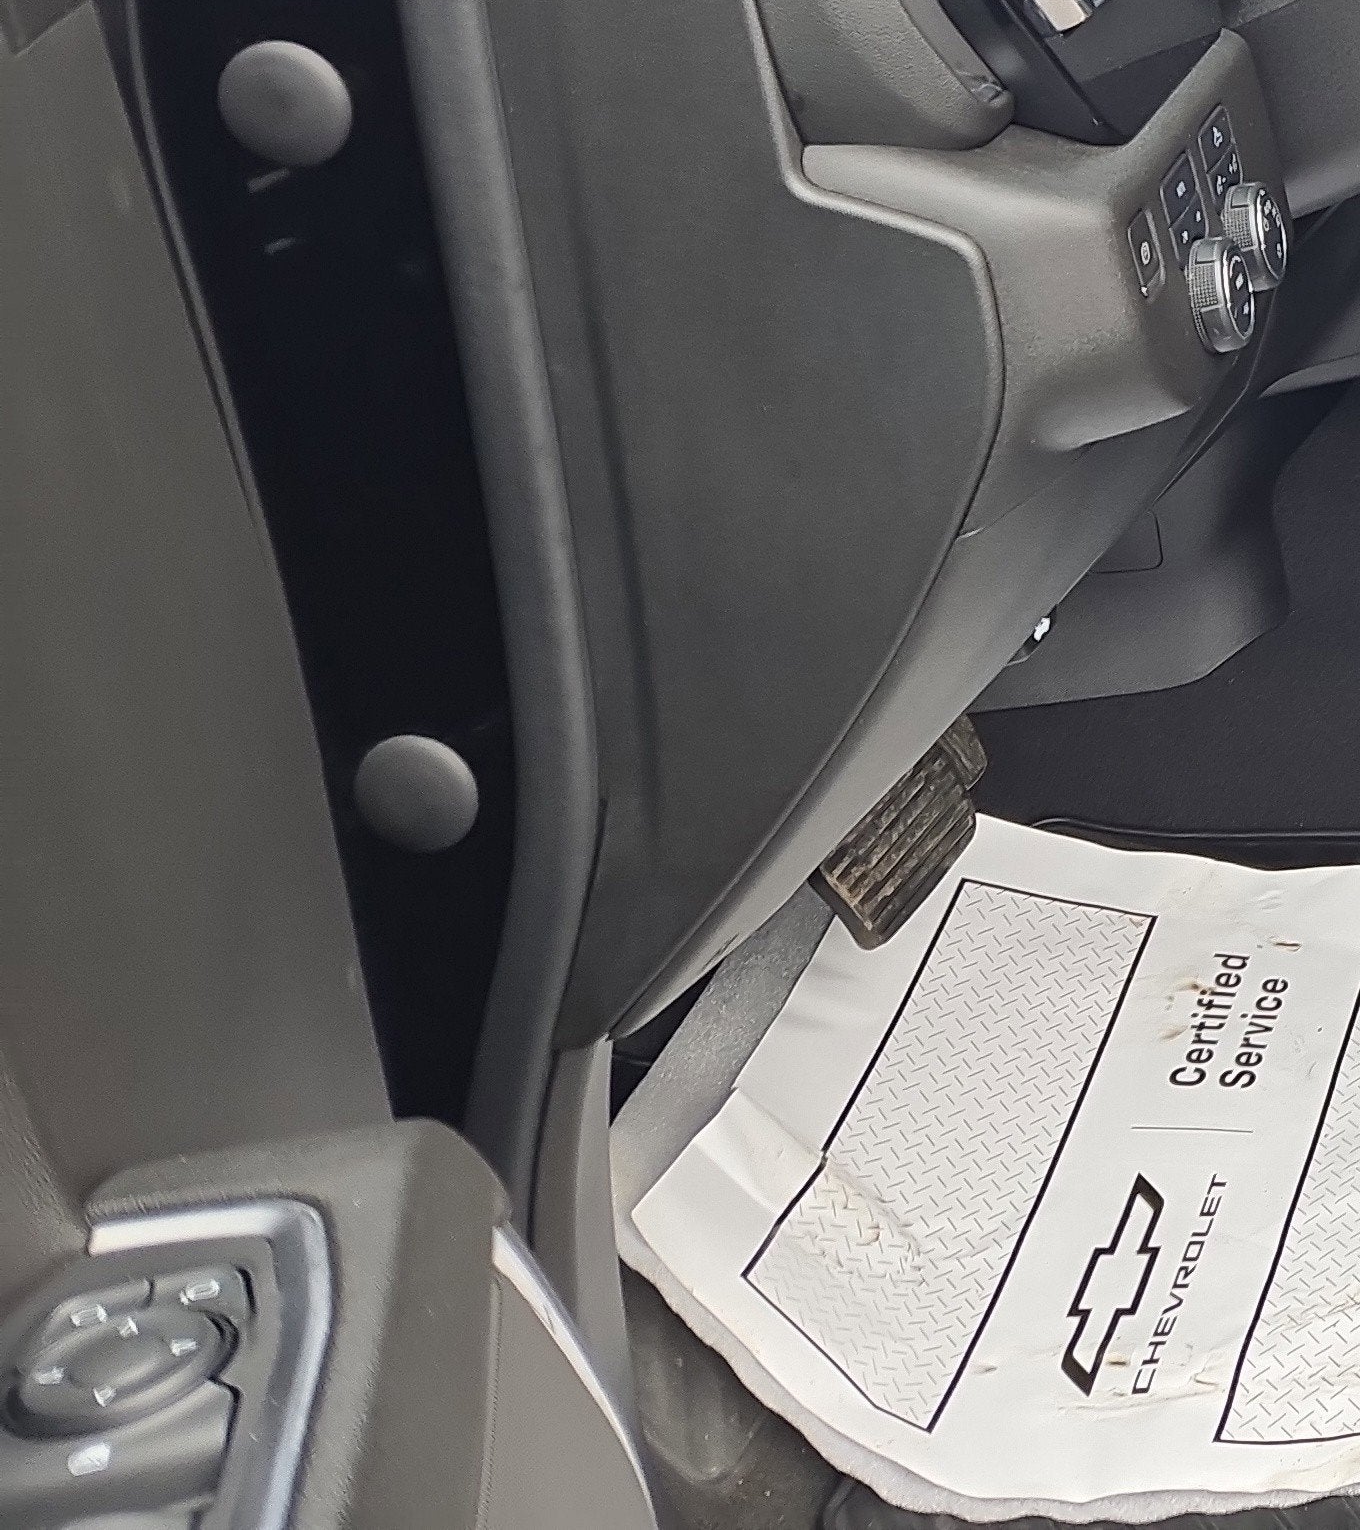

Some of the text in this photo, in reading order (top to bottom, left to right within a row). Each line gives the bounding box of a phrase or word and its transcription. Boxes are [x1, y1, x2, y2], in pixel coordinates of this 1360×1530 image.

[1169, 952, 1251, 1087] Certified
[1218, 977, 1289, 1089] Service
[1131, 1173, 1228, 1395] CHEVROLET
